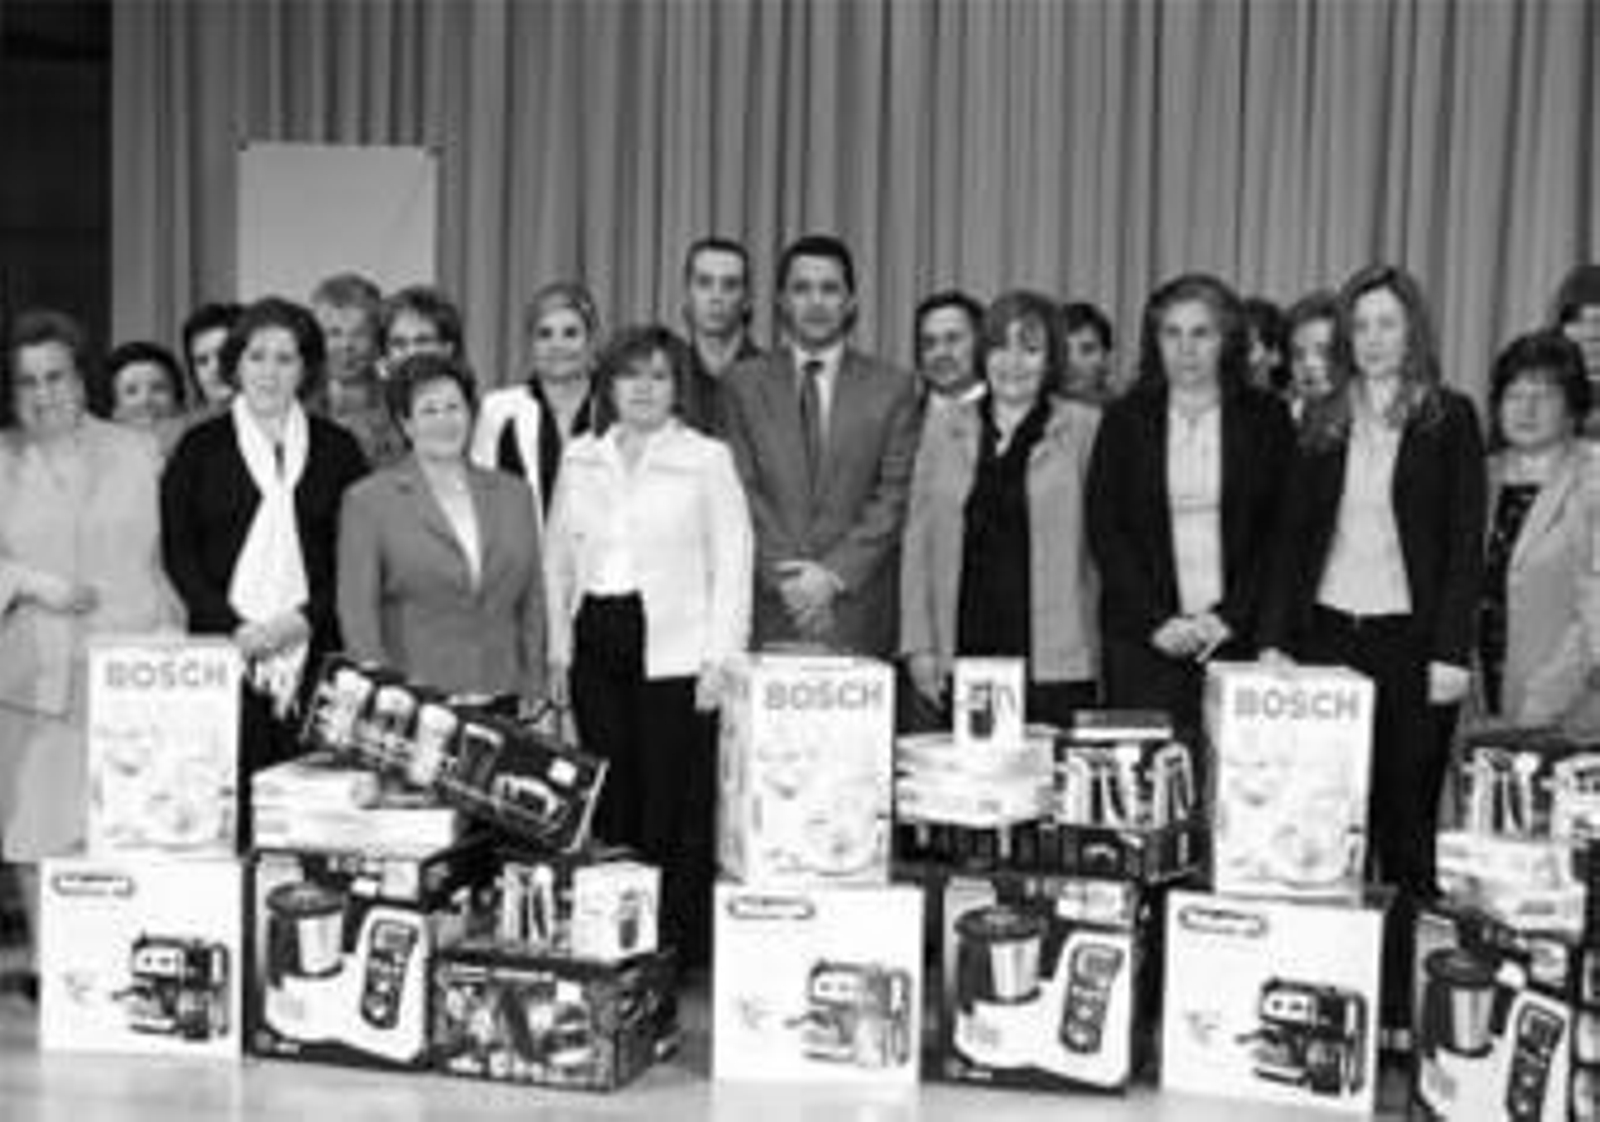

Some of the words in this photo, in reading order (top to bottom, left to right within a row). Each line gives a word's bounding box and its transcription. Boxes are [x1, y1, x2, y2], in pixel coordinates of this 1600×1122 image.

[106, 661, 228, 688] BOSCH
[764, 681, 884, 710] BOSCH
[1235, 689, 1359, 719] BOSCH
